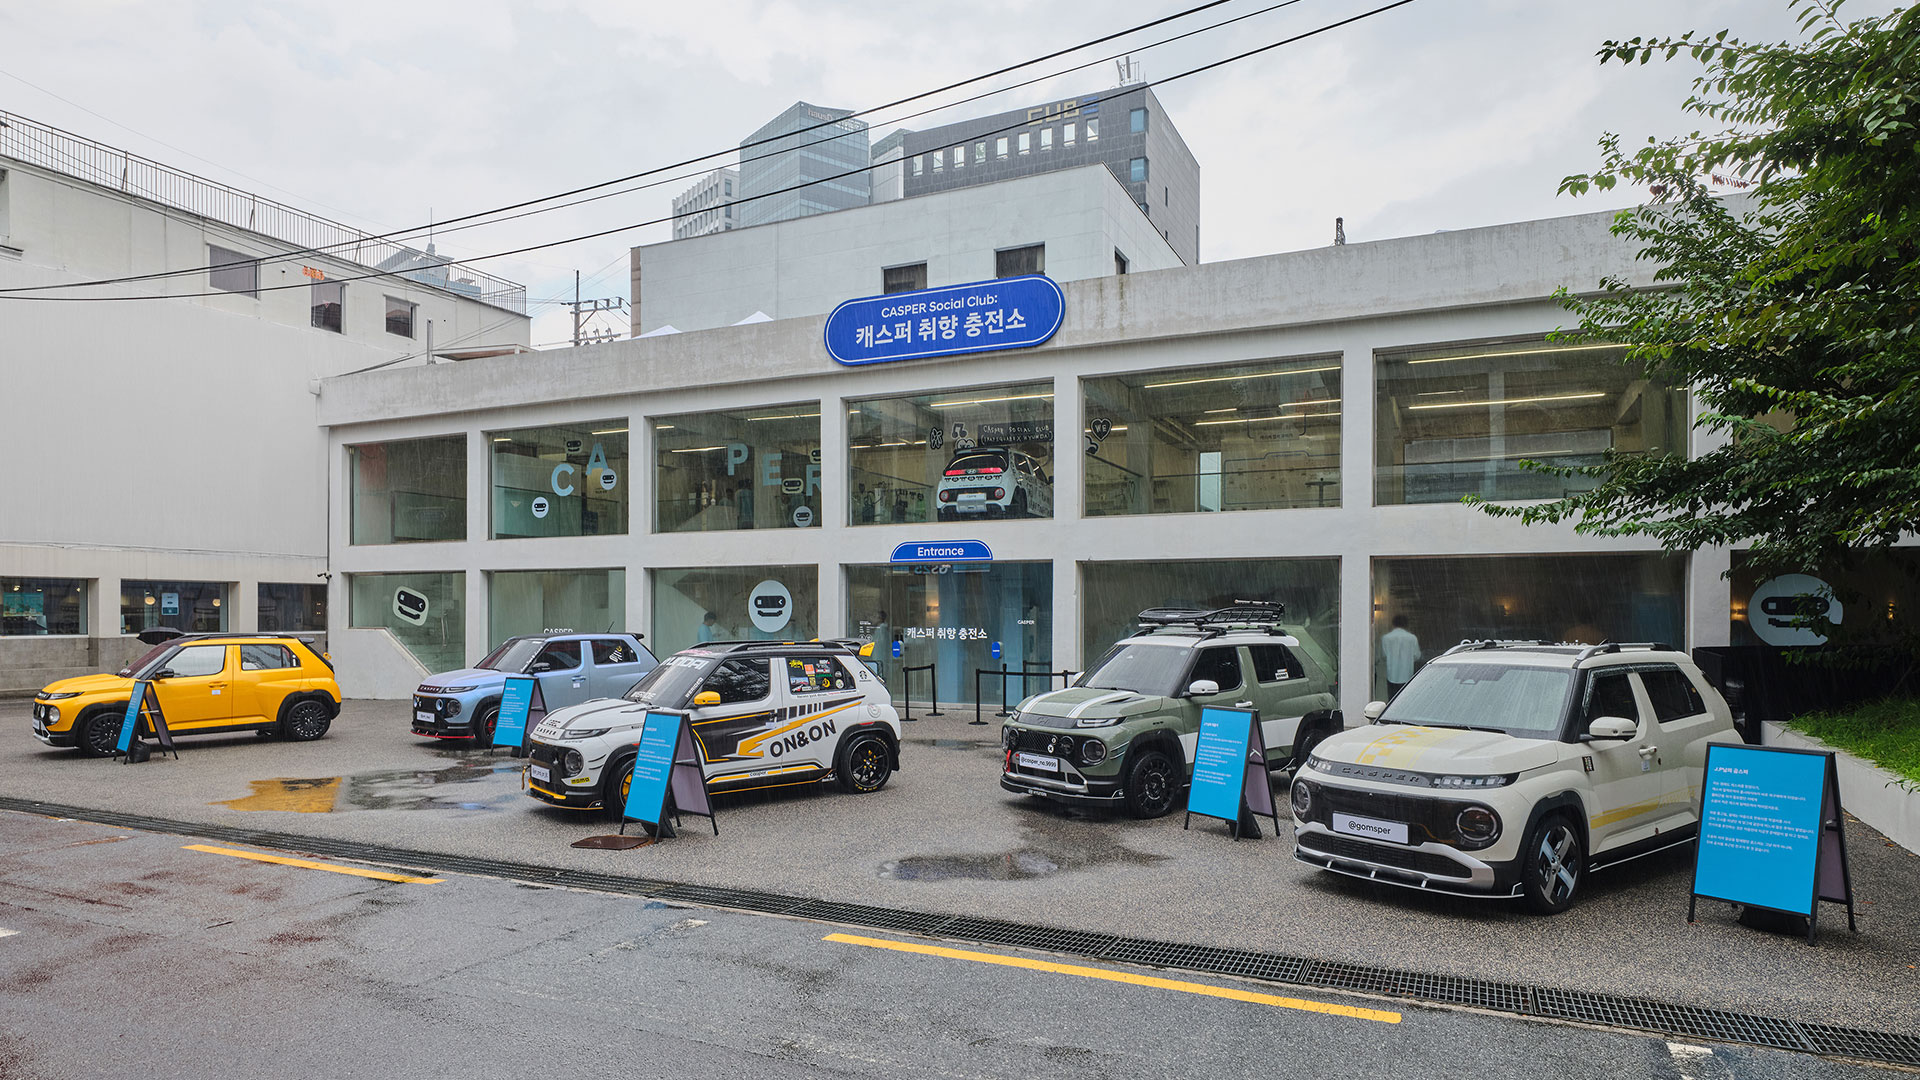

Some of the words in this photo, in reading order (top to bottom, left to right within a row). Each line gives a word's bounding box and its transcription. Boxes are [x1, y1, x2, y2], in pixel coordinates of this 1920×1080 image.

[881, 303, 927, 318] CASPER
[929, 297, 965, 312] Social
[967, 293, 999, 308] Club:
[855, 319, 912, 348] 캐스퍼
[918, 315, 958, 342] 취향
[963, 308, 1027, 338] 충전소
[917, 546, 965, 558] Entrance
[906, 627, 935, 640] 캐스퍼
[936, 627, 957, 640] 취향
[958, 627, 988, 641] 충전소
[536, 726, 557, 736] CASPER
[769, 718, 837, 758] ON&ON
[1341, 767, 1420, 783] CASPER
[1348, 820, 1391, 835] @gomsper
